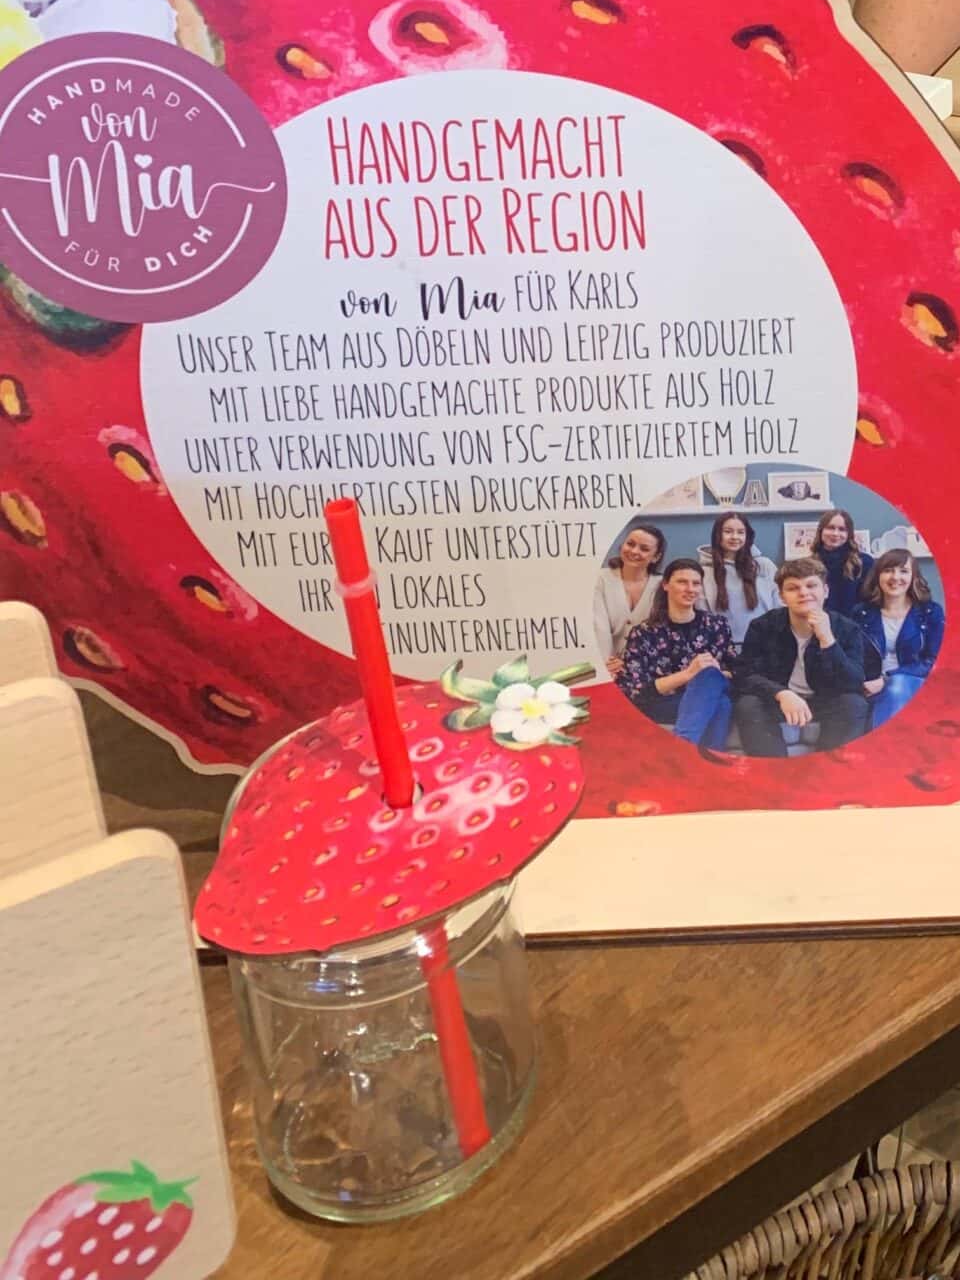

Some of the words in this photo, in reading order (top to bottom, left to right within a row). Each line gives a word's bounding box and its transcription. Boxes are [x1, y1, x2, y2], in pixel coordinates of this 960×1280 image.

[27, 77, 201, 125] HANDMADE
[81, 102, 158, 143] von
[327, 116, 626, 186] HANDGEMACHT
[48, 139, 208, 237] Mia
[64, 240, 120, 272] FÜR
[144, 224, 214, 272] DICH
[325, 197, 398, 260] AUS
[413, 194, 487, 257] DER
[502, 187, 646, 255] REGION
[340, 289, 398, 319] von
[419, 275, 506, 321] Mia
[514, 270, 558, 312] FÜR
[568, 269, 639, 311] KARLS
[176, 332, 257, 374] UNSER
[264, 331, 331, 371] TEAM
[342, 331, 388, 369] AUS
[396, 326, 491, 368] DÖBELN
[501, 326, 553, 365] UND
[563, 322, 650, 362] LEIPZIG
[660, 317, 796, 358] PRODUZIERT
[210, 386, 249, 423] MIT
[261, 384, 324, 422] LIEBE
[332, 378, 527, 420] HANDGEMACHTE
[536, 373, 655, 413] PRODUKTE
[665, 371, 710, 409] AUS
[719, 367, 776, 407] HOLZ
[184, 436, 262, 474] UNTER
[268, 431, 435, 471] VERWENDUNG
[443, 429, 493, 465] VON
[502, 420, 734, 464] FSC-ZERTIFIZIERTEM
[744, 416, 800, 456] HOLZ
[204, 486, 244, 521] MIT
[470, 473, 642, 514] DRUCKFARBEN.
[237, 530, 278, 568] MIT
[289, 531, 334, 567] EUR
[375, 526, 433, 564] KAUF
[445, 520, 598, 562] UNTERSTÜTZT
[298, 579, 335, 612] IHR
[390, 573, 486, 610] LOKALES
[380, 616, 586, 655] INUNTERNEHMEN.
